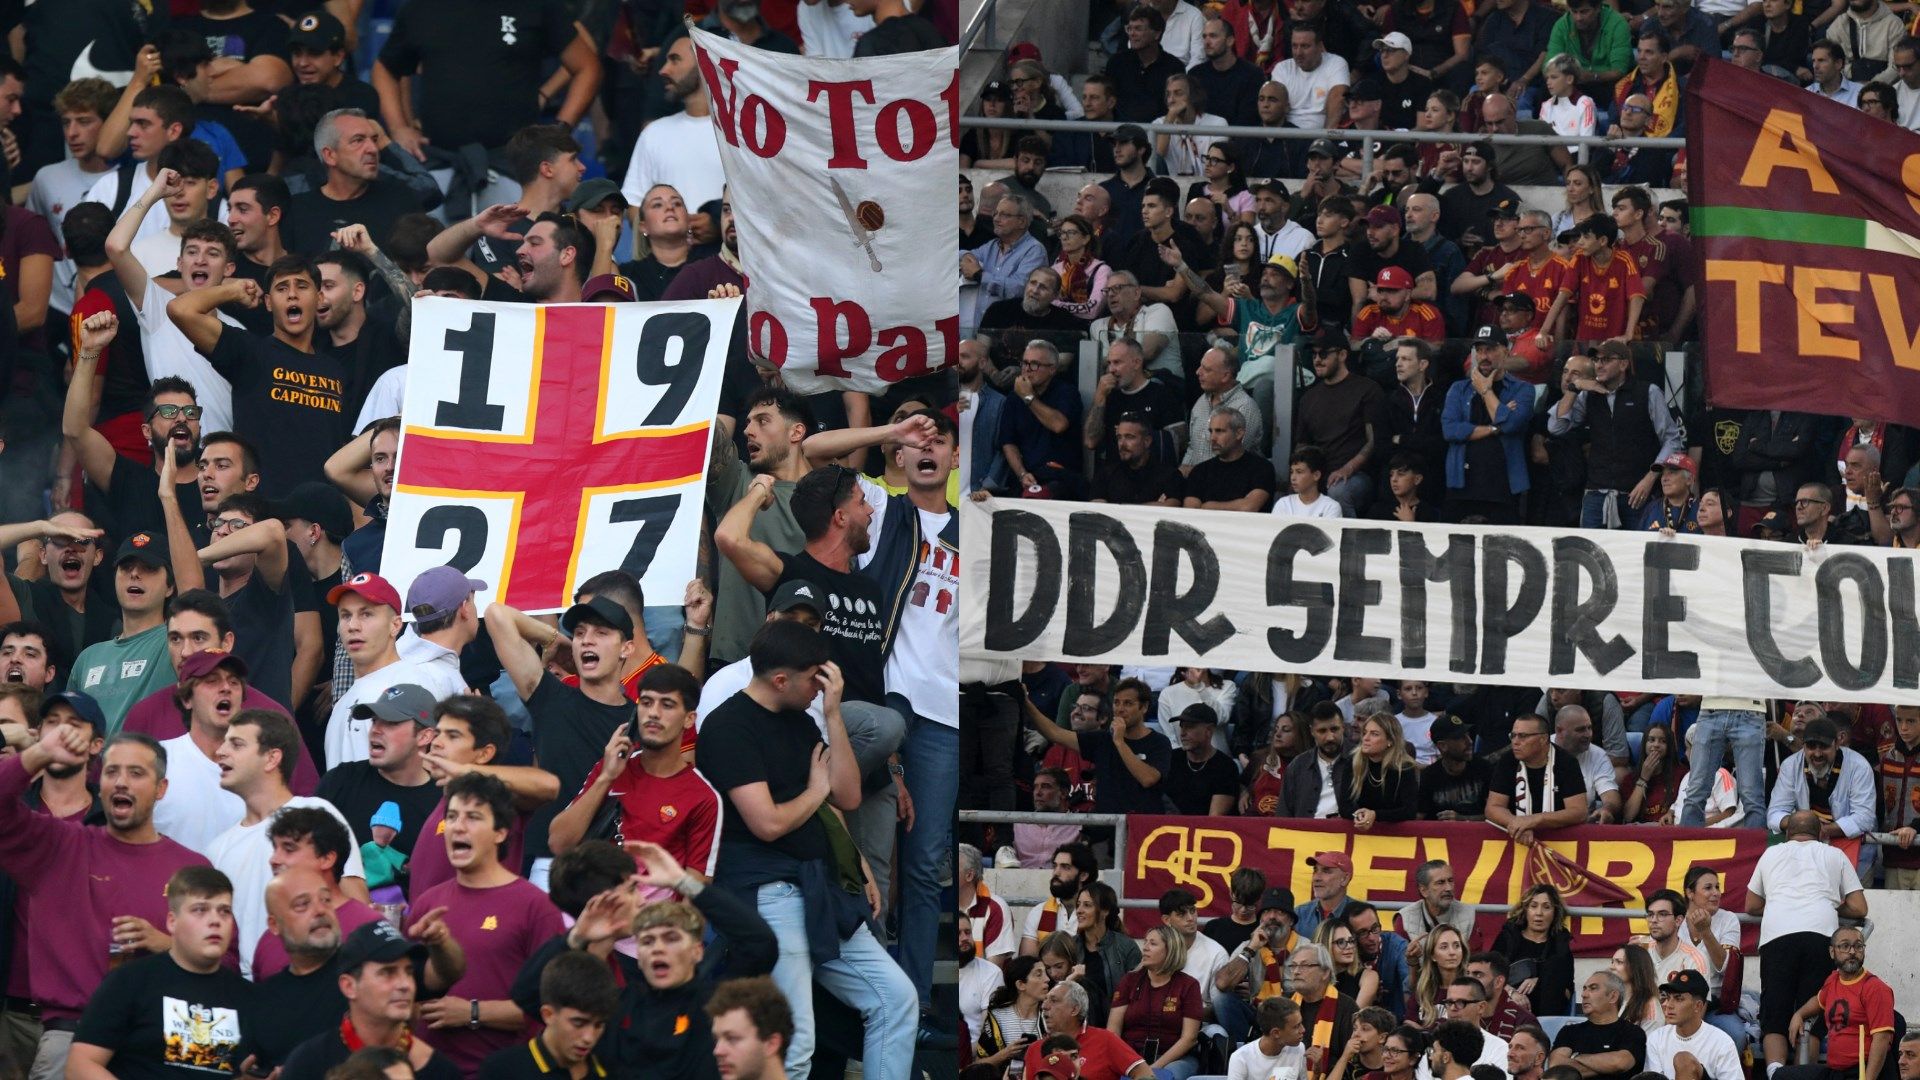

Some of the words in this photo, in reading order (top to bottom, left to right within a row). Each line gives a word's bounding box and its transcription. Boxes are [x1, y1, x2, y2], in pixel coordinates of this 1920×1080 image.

[501, 15, 517, 33] K
[694, 43, 787, 159] No
[272, 367, 343, 395] GIOVENTÙ
[270, 387, 342, 412] CAPITOLIN
[984, 509, 1237, 656] DDR
[1266, 523, 1702, 681] SEMPRE
